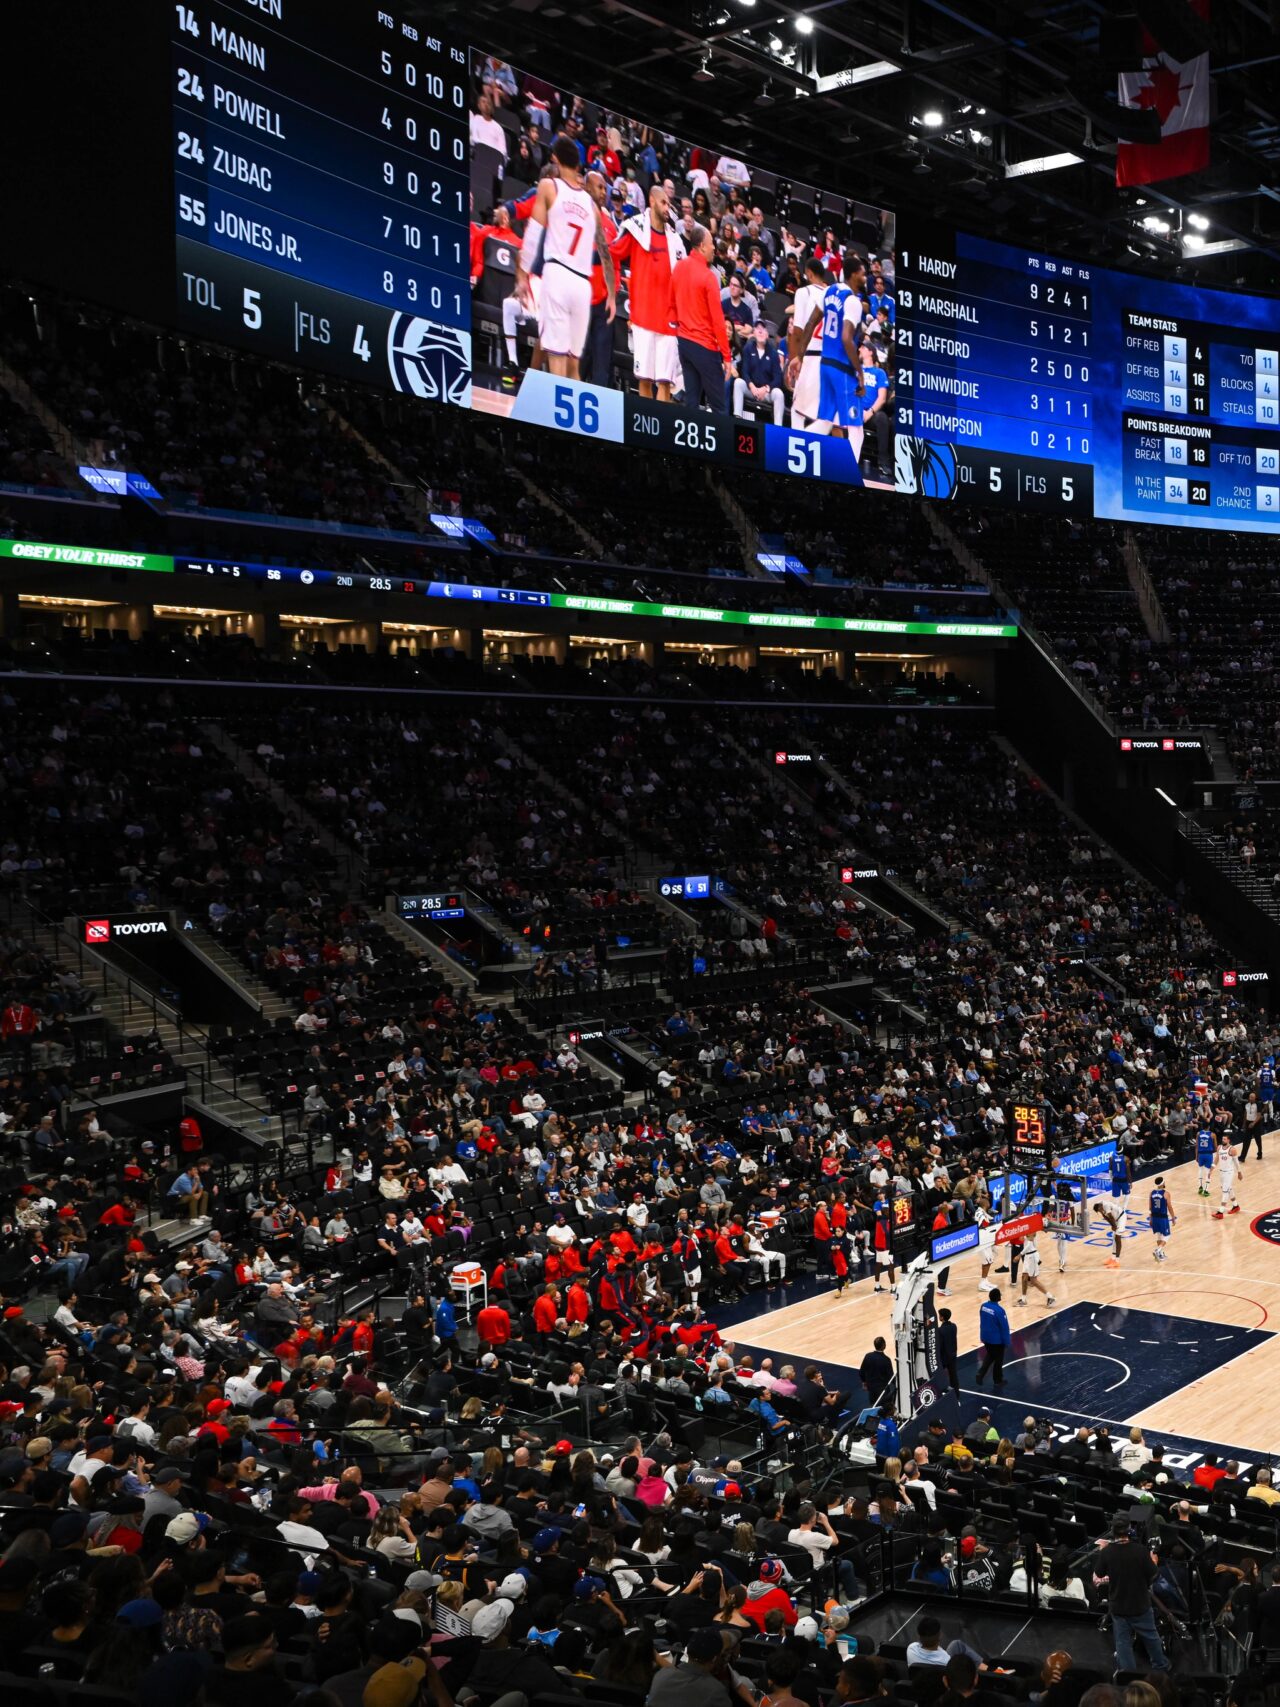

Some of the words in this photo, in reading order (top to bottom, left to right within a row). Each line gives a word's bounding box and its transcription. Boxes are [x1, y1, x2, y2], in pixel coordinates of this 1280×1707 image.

[378, 10, 394, 29] PTS
[402, 23, 418, 42] REB
[426, 36, 442, 53] AST
[451, 48, 465, 64] FLS
[176, 5, 199, 37] 14
[211, 22, 265, 71] MANN
[381, 107, 392, 130] 4
[406, 118, 416, 141] 0
[430, 128, 440, 151] 0
[453, 138, 464, 161] 0
[381, 51, 392, 75] 5
[406, 63, 416, 87] 0
[425, 72, 443, 99] 10
[453, 86, 463, 108] 0
[177, 68, 204, 102] 24
[213, 84, 286, 140] POWELL
[383, 162, 394, 185] 9
[408, 172, 418, 195] 0
[431, 181, 441, 205] 2
[177, 131, 204, 165] 24
[213, 145, 272, 192] ZUBAC
[403, 224, 420, 249] 10
[567, 222, 583, 256] 7
[179, 194, 206, 227] 55
[214, 210, 272, 251] JONES
[276, 234, 302, 262] JR.
[383, 270, 393, 294] 8
[407, 279, 417, 301] 3
[431, 287, 441, 309] 0
[919, 255, 957, 279] HARDY
[898, 290, 912, 308] 13
[919, 295, 979, 324] MARSHALL
[183, 272, 222, 311] TOL
[243, 287, 262, 330] 5
[300, 311, 331, 344] FLS
[353, 324, 371, 362] 4
[1128, 314, 1151, 328] TEAM
[1153, 319, 1177, 332] STATS
[899, 329, 912, 346] 21
[919, 333, 970, 359] GAFFORD
[1126, 337, 1142, 348] OFF
[1144, 339, 1159, 351] REB
[1126, 364, 1142, 375] DEF
[1144, 366, 1159, 378] REB
[1170, 370, 1181, 383] 14
[1193, 373, 1205, 386] 16
[899, 369, 913, 386] 21
[919, 372, 979, 399] DINWIDDIE
[1221, 378, 1253, 391] BLOCKS
[1126, 389, 1160, 403] ASSISTS
[1223, 403, 1253, 415] STEALS
[554, 385, 599, 433] 56
[633, 413, 660, 436] 2ND
[674, 419, 717, 453] 28.5
[738, 433, 754, 454] 23
[787, 436, 821, 477] 51
[899, 408, 913, 425] 31
[919, 411, 982, 437] THOMPSON
[1128, 418, 1157, 432] POINTS
[1159, 422, 1211, 438] BREAKDOWN
[1140, 437, 1161, 449] FAST
[1135, 449, 1161, 462] BREAK
[1219, 452, 1235, 464] OFF
[1262, 456, 1275, 468] 20
[989, 466, 1001, 492] 5
[1026, 475, 1046, 494] FLS
[1062, 477, 1073, 501] 5
[1145, 477, 1161, 488] THE
[1137, 488, 1161, 500] PAINT
[1170, 485, 1182, 498] 34
[1192, 487, 1206, 500] 20
[1234, 486, 1250, 497] 2ND
[1216, 497, 1250, 509] CHANCE
[12, 543, 54, 559] OBEY
[54, 547, 94, 563] YOUR
[207, 563, 214, 574] 4
[233, 566, 240, 577] 5
[267, 569, 280, 580] 56
[336, 576, 353, 586] 2ND
[370, 577, 391, 590] 28.5
[404, 582, 413, 592] 23
[472, 588, 481, 598] 51
[510, 591, 515, 601] 5
[540, 595, 545, 604] 5
[565, 597, 585, 608] OBEY
[662, 606, 681, 616] OBEY
[749, 614, 769, 624] OBEY
[936, 625, 957, 634] OBEY
[854, 870, 878, 878] TOYOTA
[422, 898, 441, 909] 28.5
[113, 922, 167, 936] TOYOTA
[1238, 972, 1268, 981] TOYOTA
[1014, 1107, 1038, 1120] 28.5
[1017, 1120, 1042, 1144] 23
[1021, 1147, 1045, 1155] TISSOT
[1060, 1150, 1114, 1176] ticketmaster
[896, 1209, 909, 1224] 23
[935, 1232, 976, 1254] ticketmaster
